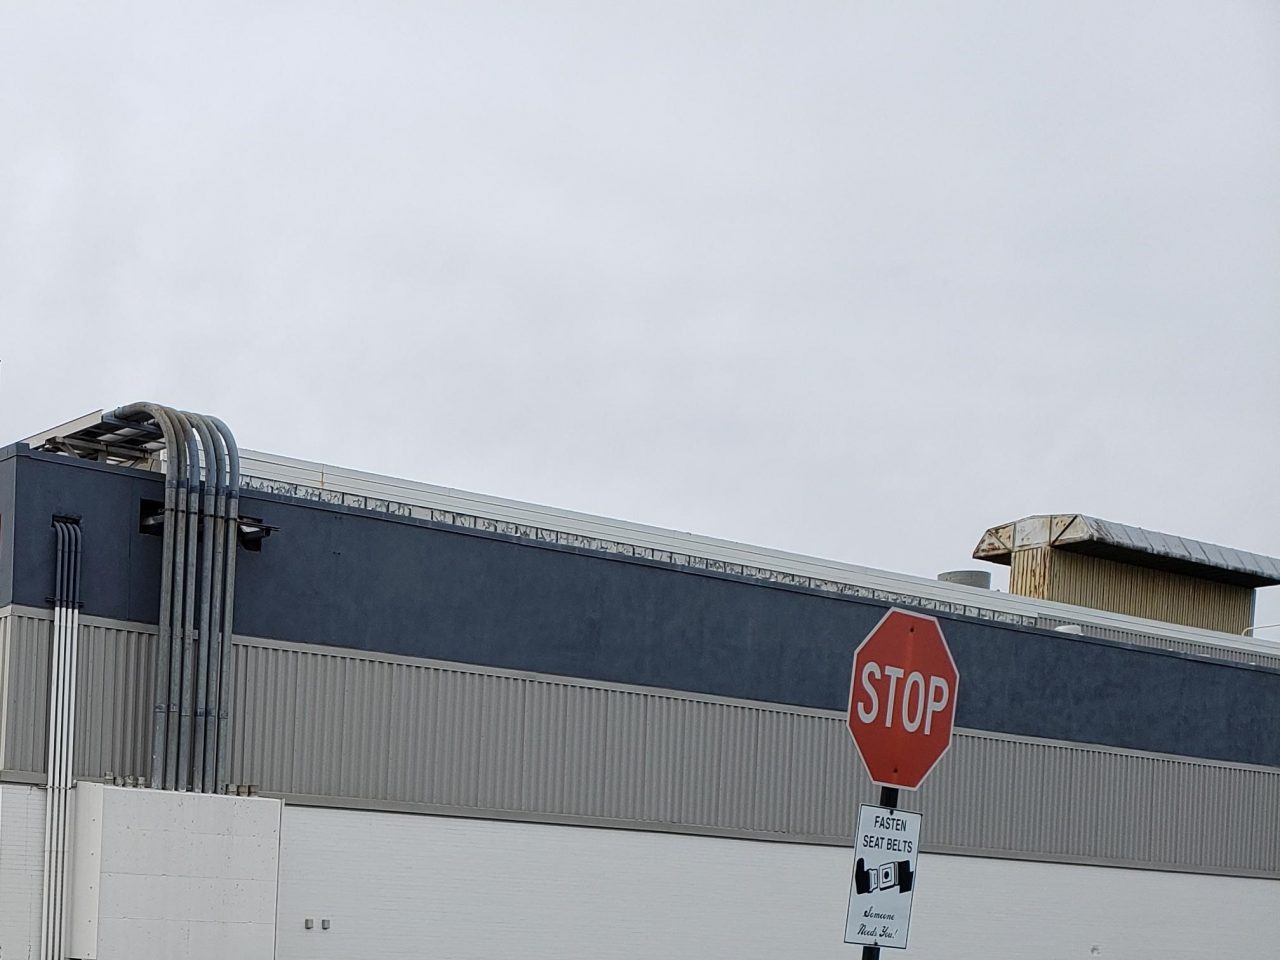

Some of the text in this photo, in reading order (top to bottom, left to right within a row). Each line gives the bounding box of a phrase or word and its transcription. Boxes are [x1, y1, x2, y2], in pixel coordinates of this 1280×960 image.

[857, 661, 949, 735] STOP
[873, 815, 907, 831] FASTEN
[862, 835, 913, 853] SEAT BELTS
[863, 906, 895, 921] Someone
[857, 923, 898, 939] Needs You!
